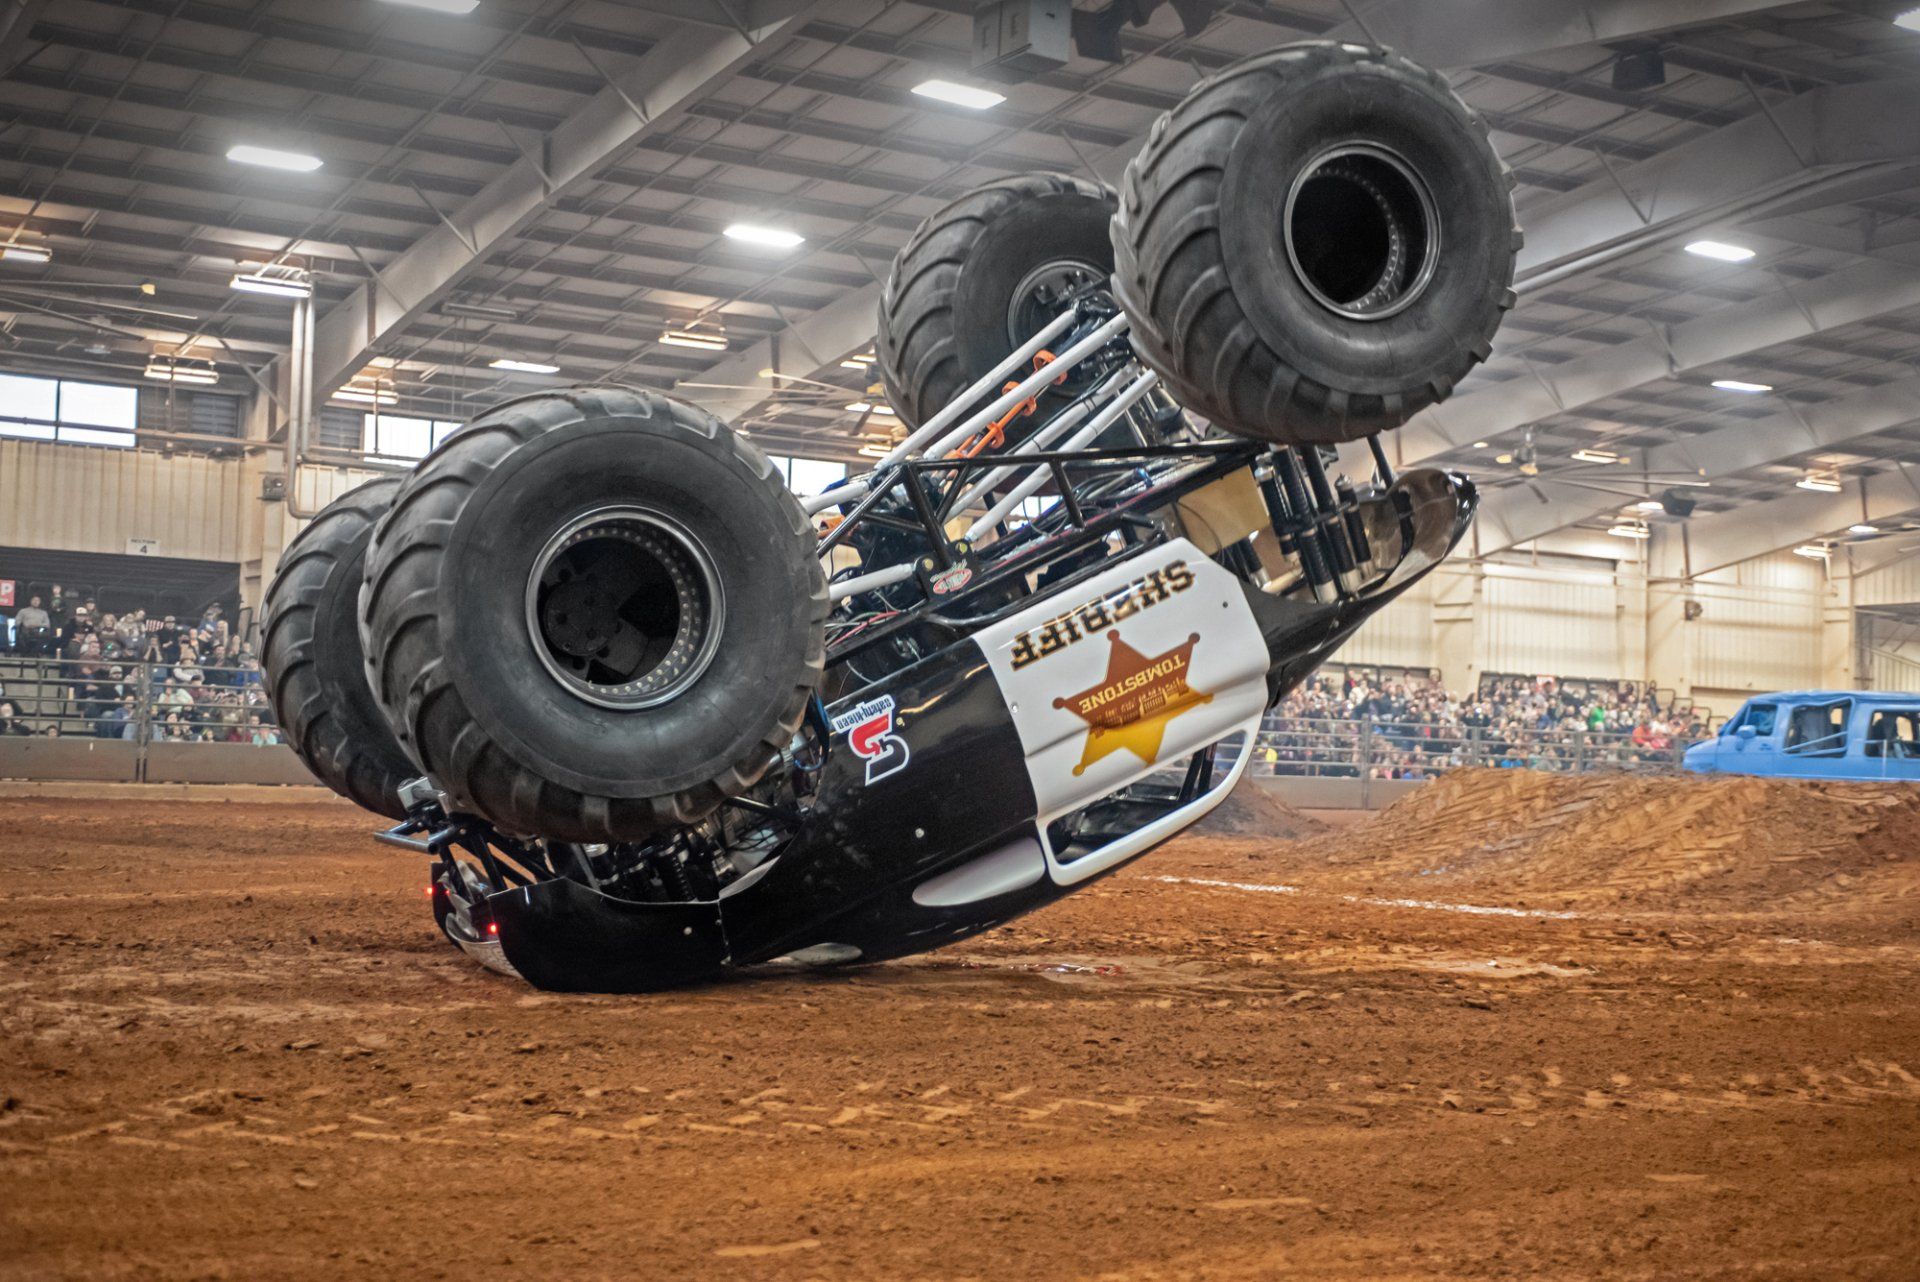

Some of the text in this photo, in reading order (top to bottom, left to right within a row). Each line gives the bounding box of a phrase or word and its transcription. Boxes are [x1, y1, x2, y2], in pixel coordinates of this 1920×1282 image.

[140, 545, 147, 554] 4
[1010, 559, 1196, 672] SHERIFF
[1079, 654, 1185, 714] TOMBSTONE
[836, 698, 892, 730] safety-kleen
